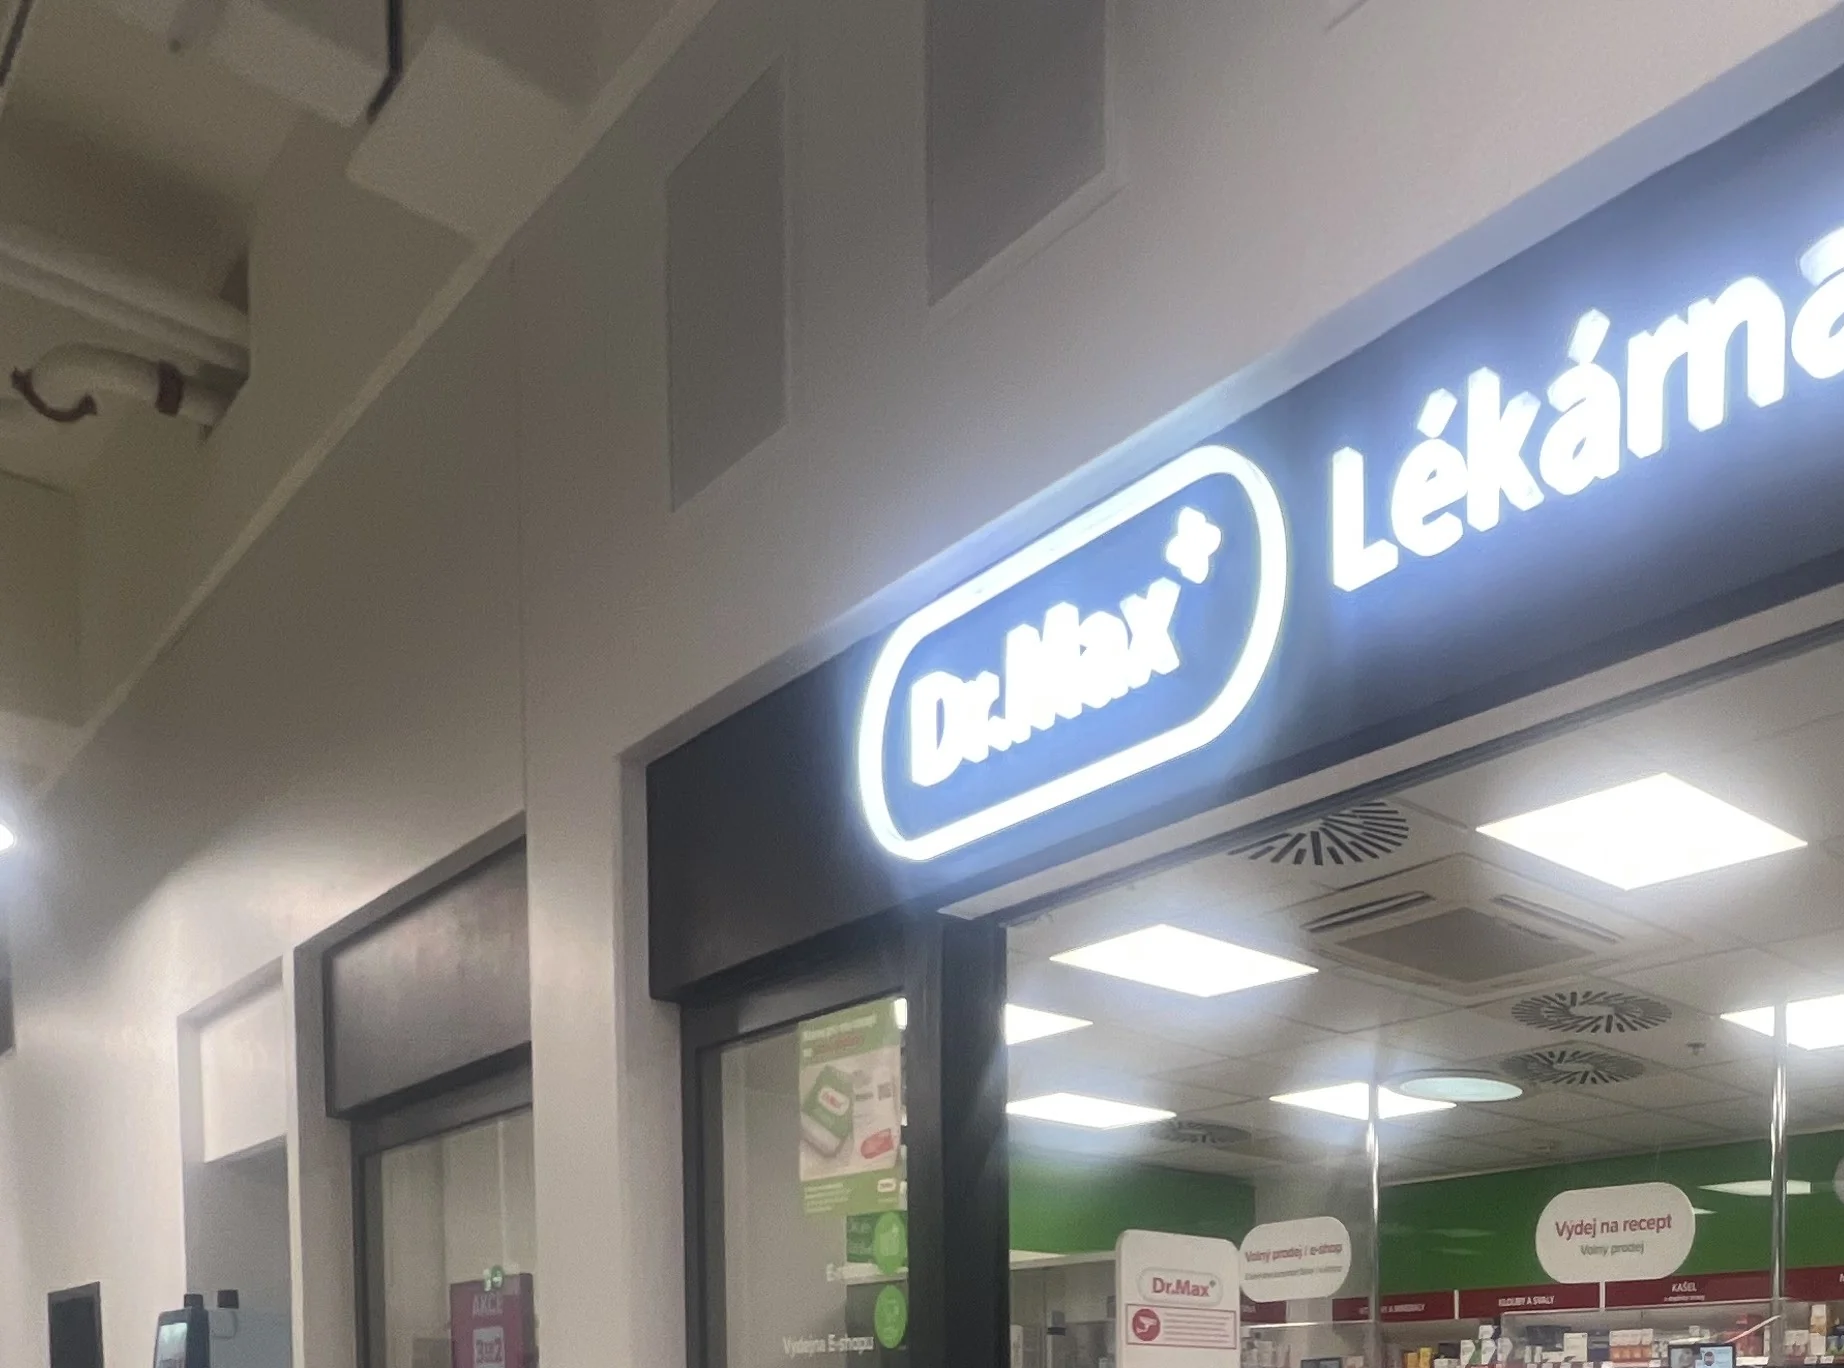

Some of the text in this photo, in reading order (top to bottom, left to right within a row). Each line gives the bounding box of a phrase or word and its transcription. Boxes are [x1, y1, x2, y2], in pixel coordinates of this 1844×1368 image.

[910, 574, 1183, 787] Dr.Max
[1600, 1220, 1620, 1234] na
[1622, 1213, 1673, 1234] recept
[1152, 1276, 1211, 1298] Dr.Max
